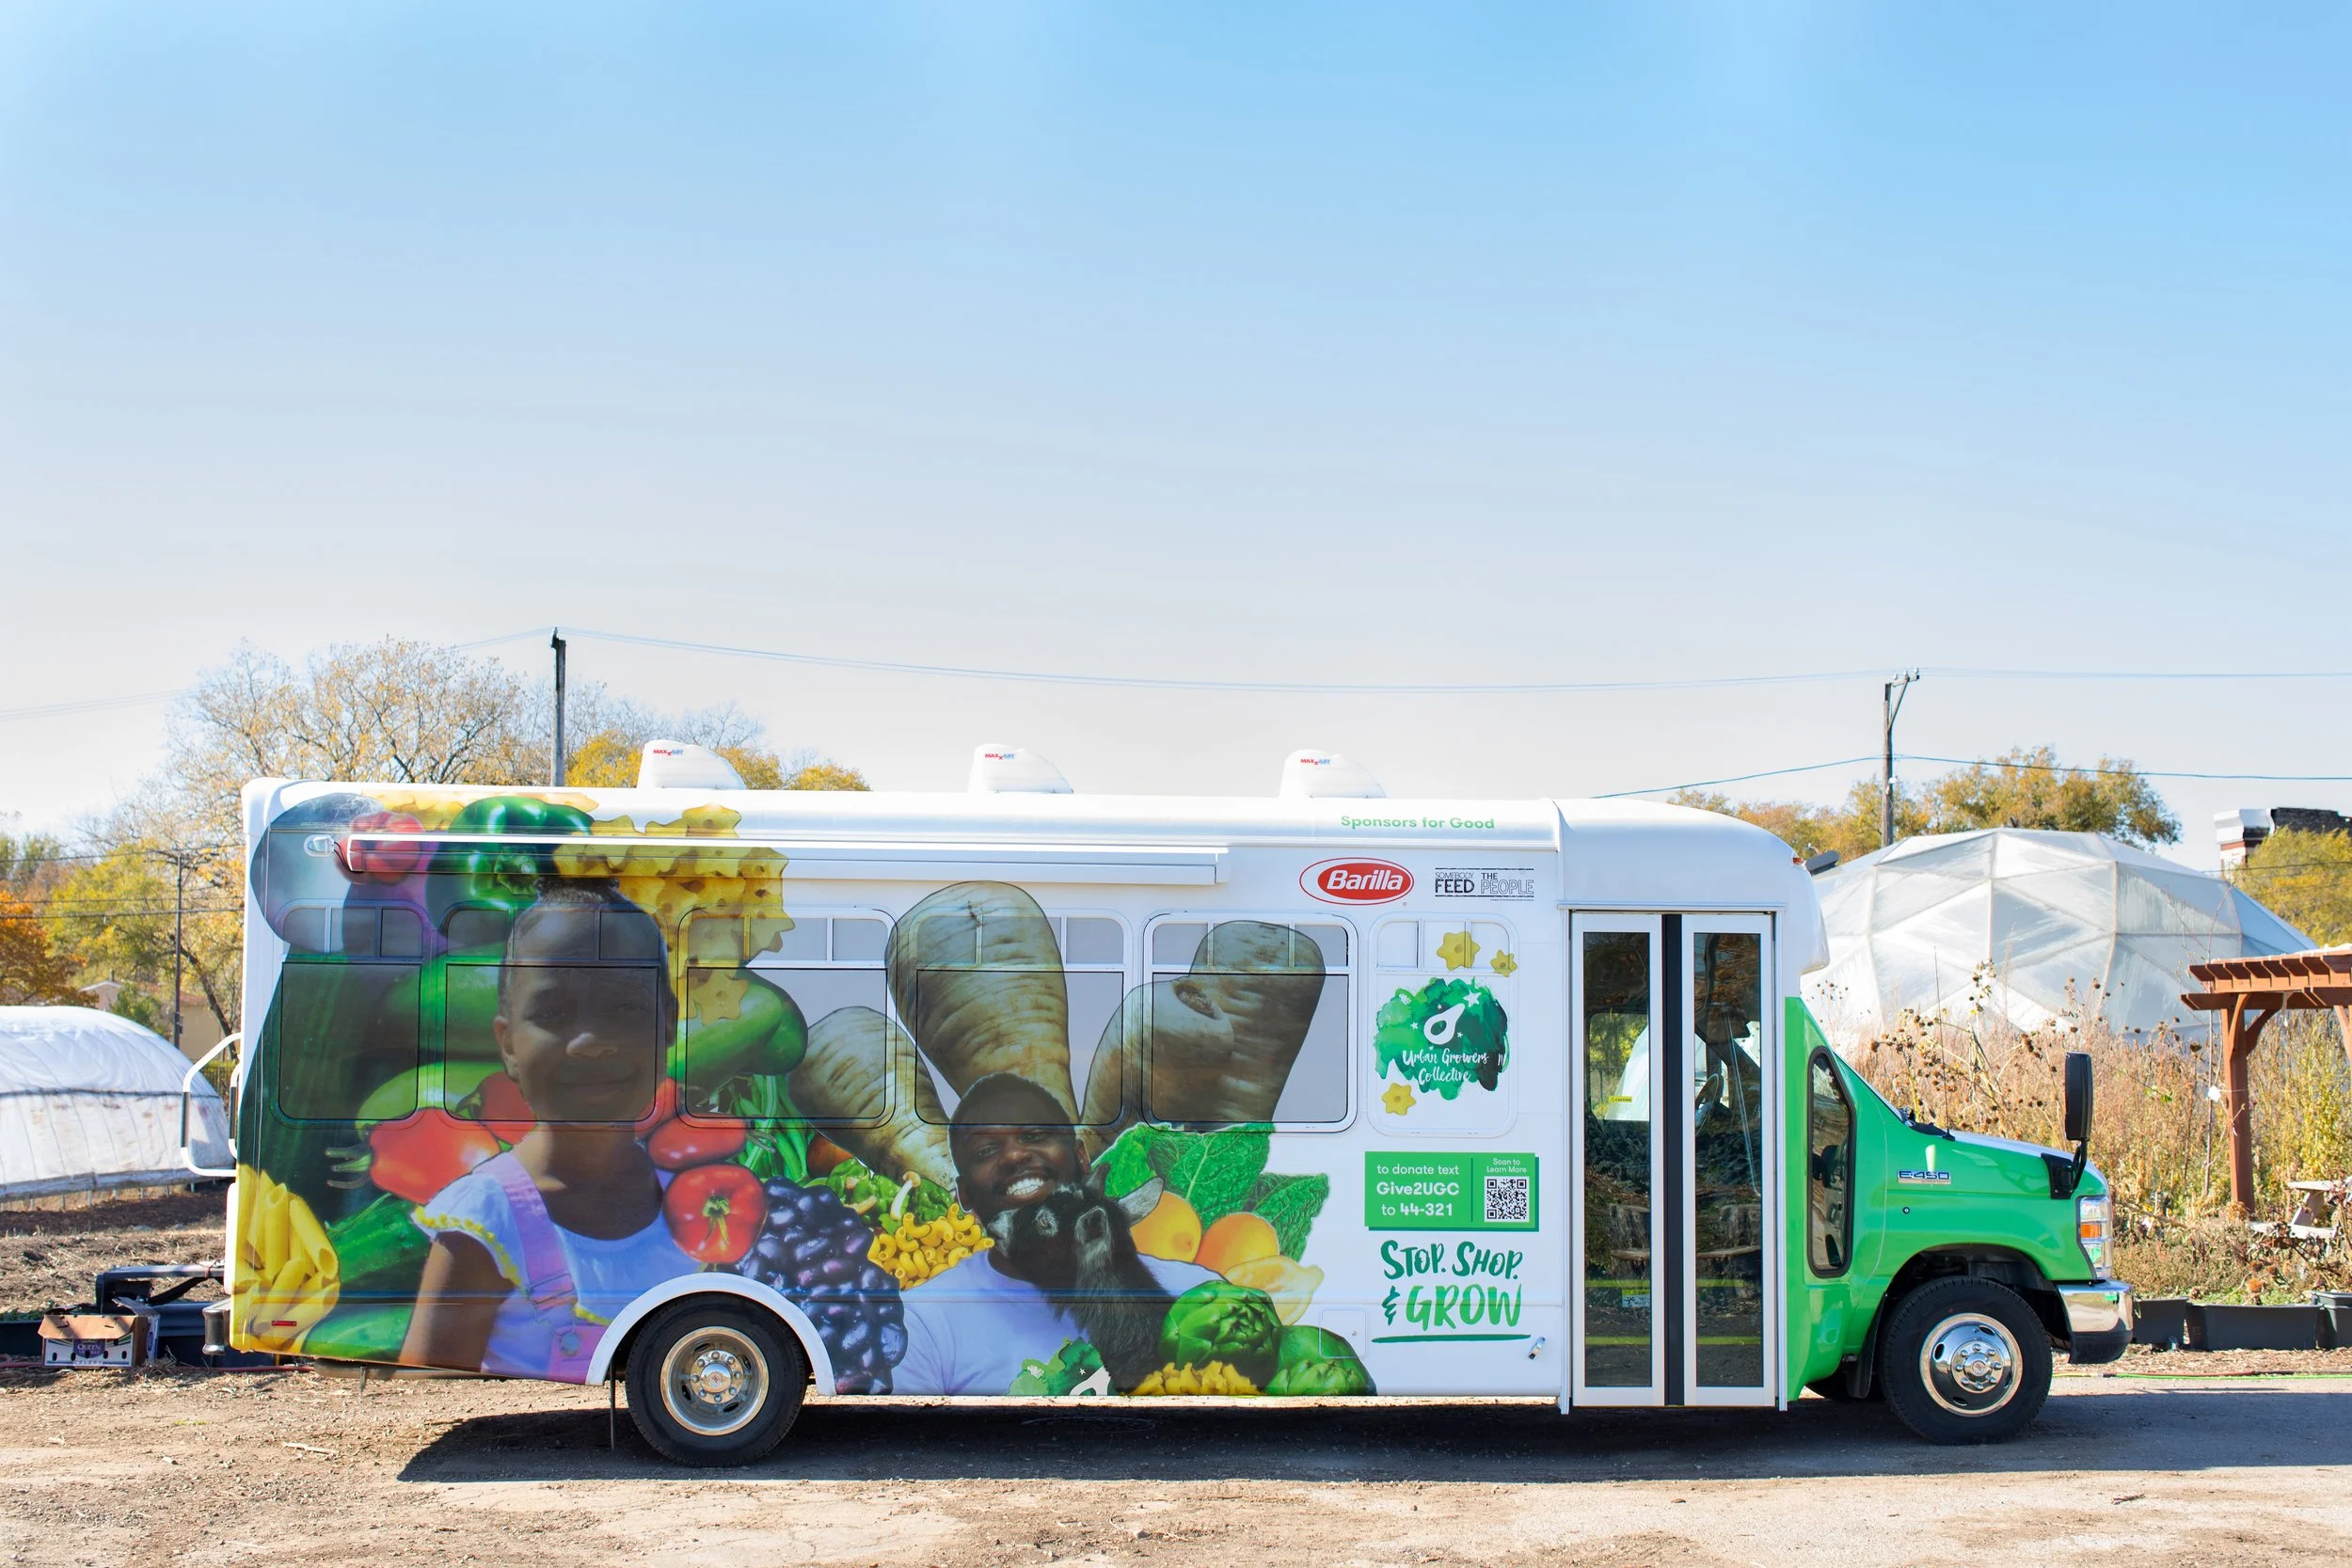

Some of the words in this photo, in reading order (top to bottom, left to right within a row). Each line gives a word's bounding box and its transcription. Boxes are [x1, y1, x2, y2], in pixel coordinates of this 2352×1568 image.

[1341, 816, 1417, 830] Sponsors
[1422, 816, 1445, 829] for
[1450, 817, 1494, 829] Good
[1327, 869, 1404, 891] Barilla
[1435, 879, 1474, 893] FEED
[1480, 879, 1534, 895] PEOPLE
[1402, 1049, 1438, 1067] Urban
[1441, 1048, 1489, 1067] Growers
[1418, 1066, 1472, 1085] Collective
[1376, 1164, 1389, 1174] to
[1392, 1164, 1435, 1175] donate
[1438, 1164, 1459, 1175] text
[1899, 1170, 1949, 1180] E-450
[1376, 1181, 1459, 1196] Give2UGC
[1381, 1204, 1396, 1216] to
[1399, 1202, 1453, 1216] 44-321
[1381, 1285, 1401, 1326] &
[1406, 1283, 1522, 1331] GROW
